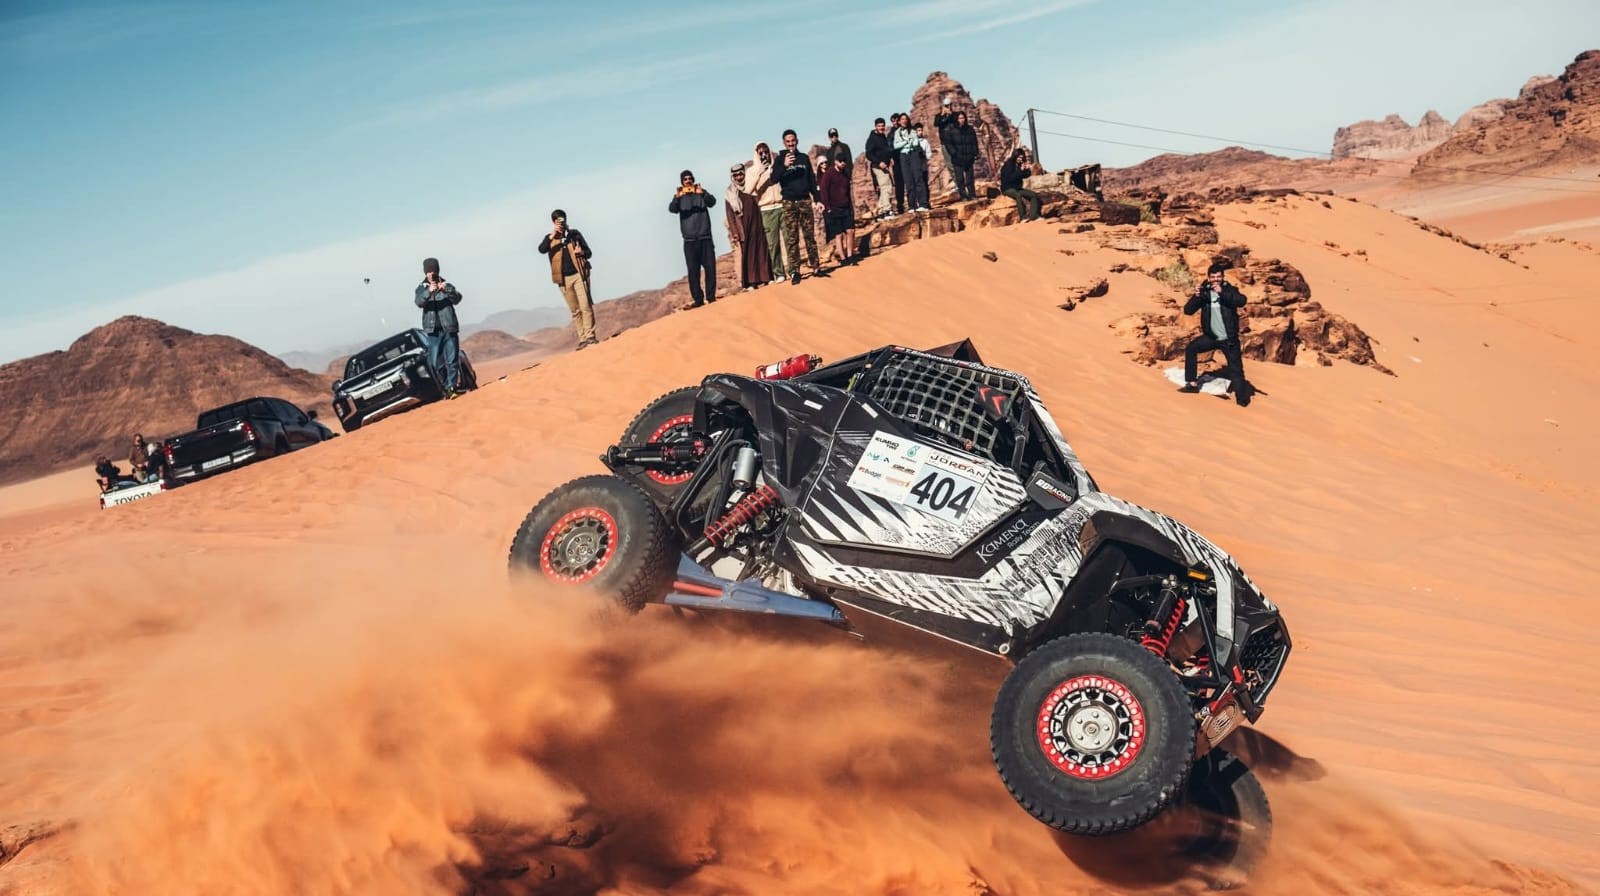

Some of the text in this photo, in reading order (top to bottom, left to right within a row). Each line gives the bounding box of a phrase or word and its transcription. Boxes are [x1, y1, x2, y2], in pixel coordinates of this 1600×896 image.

[930, 455, 986, 478] JORDAN
[114, 491, 152, 505] TOYOTA
[910, 472, 976, 519] 404
